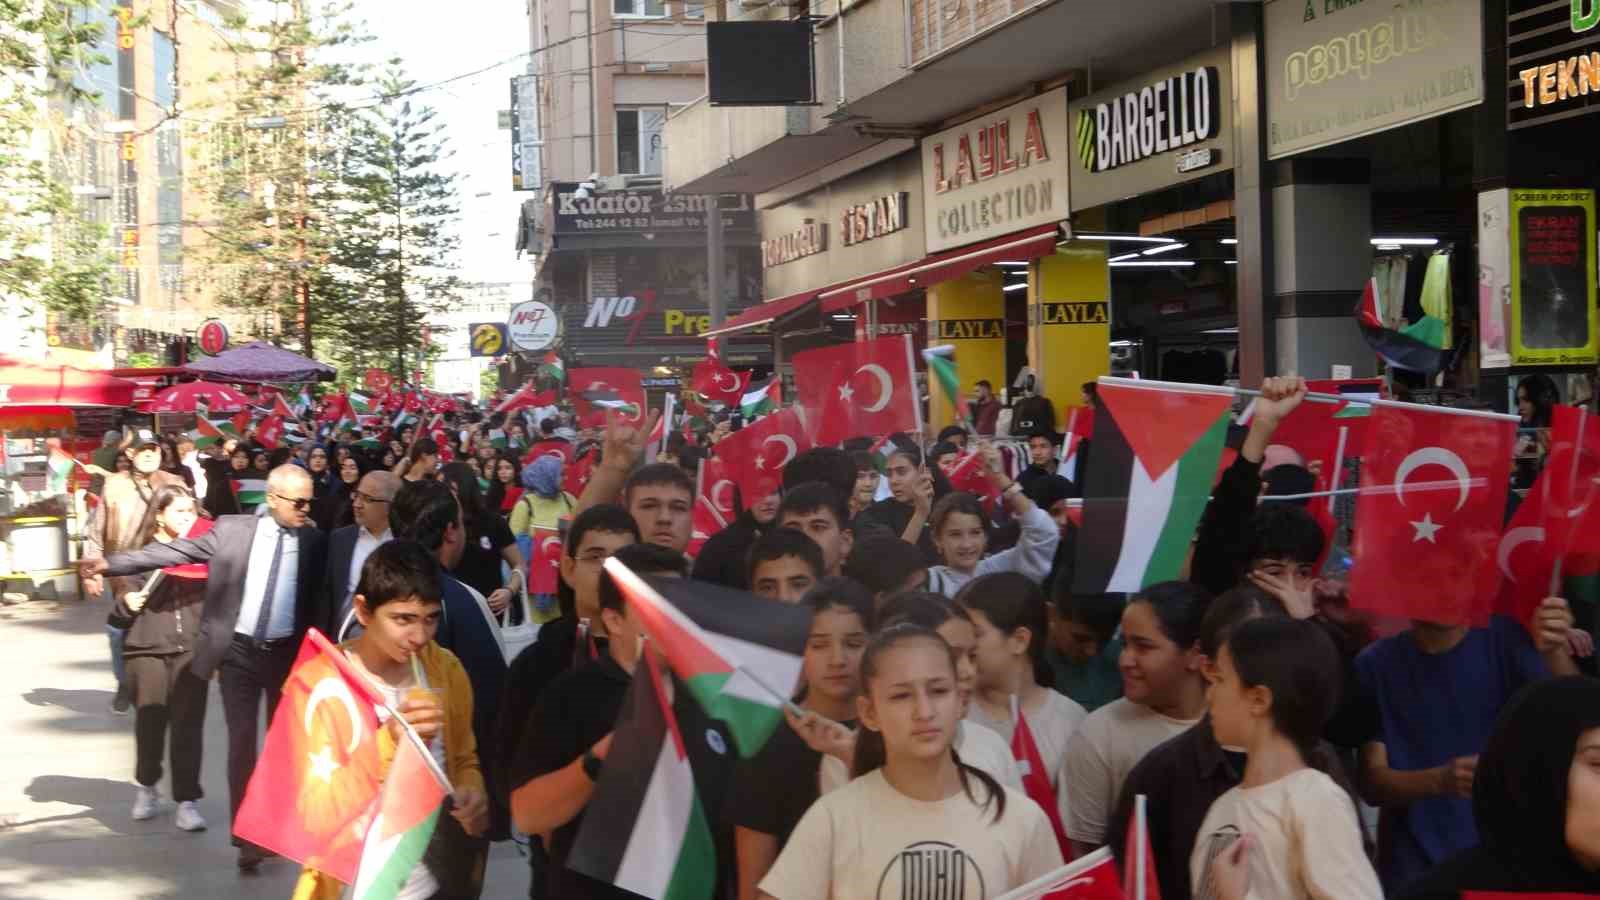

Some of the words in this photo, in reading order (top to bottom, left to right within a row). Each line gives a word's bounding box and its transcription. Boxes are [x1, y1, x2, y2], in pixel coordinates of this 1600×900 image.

[1096, 66, 1210, 171] BARGELLO
[933, 110, 1049, 195] LAYLA
[937, 178, 1054, 239] COLLECTION
[1551, 192, 1592, 201] PROTECT
[941, 320, 1003, 338] LAYLA
[1043, 303, 1107, 323] LAYLA
